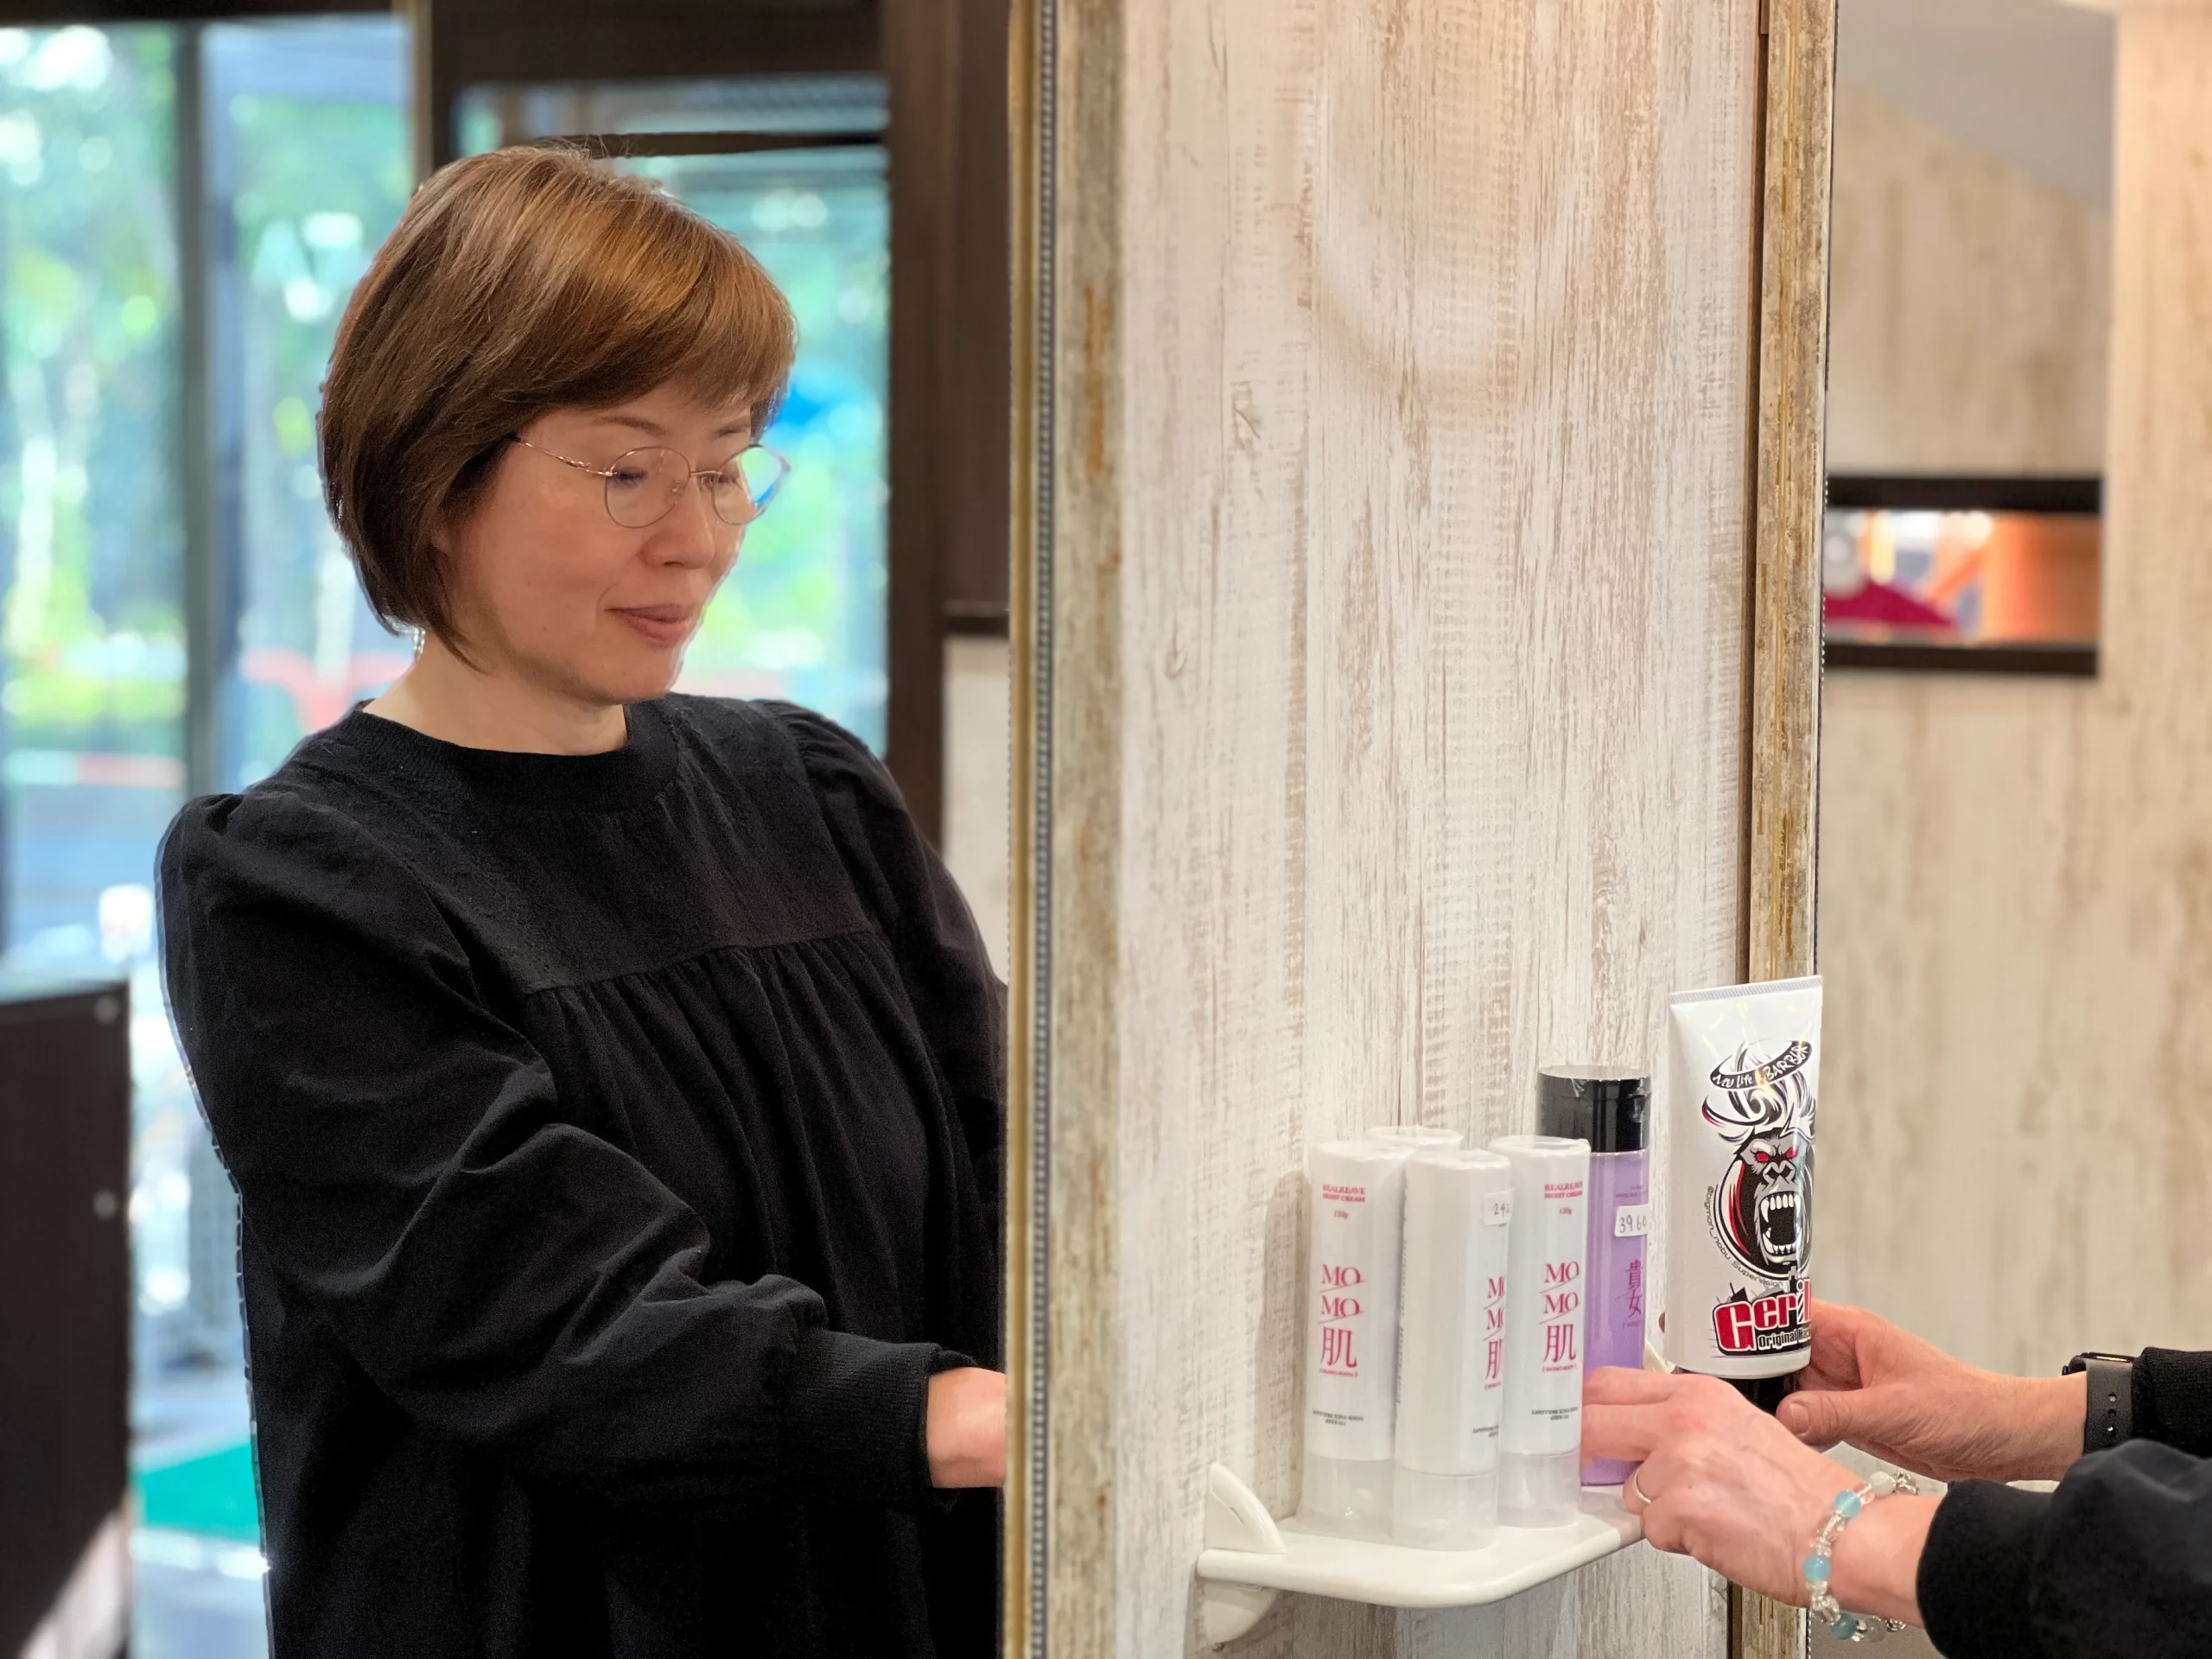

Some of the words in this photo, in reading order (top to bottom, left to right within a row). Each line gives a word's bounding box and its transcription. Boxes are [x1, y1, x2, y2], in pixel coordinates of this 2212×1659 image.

[1320, 1264, 1361, 1287] MO
[1543, 1261, 1580, 1283] MO
[1487, 1275, 1505, 1299] M
[1320, 1294, 1361, 1317] MO
[1543, 1291, 1580, 1314] MO
[1486, 1307, 1504, 1330] M
[1319, 1326, 1358, 1369] 肌
[1543, 1323, 1577, 1363] 肌
[1758, 1329, 1796, 1349] Original
